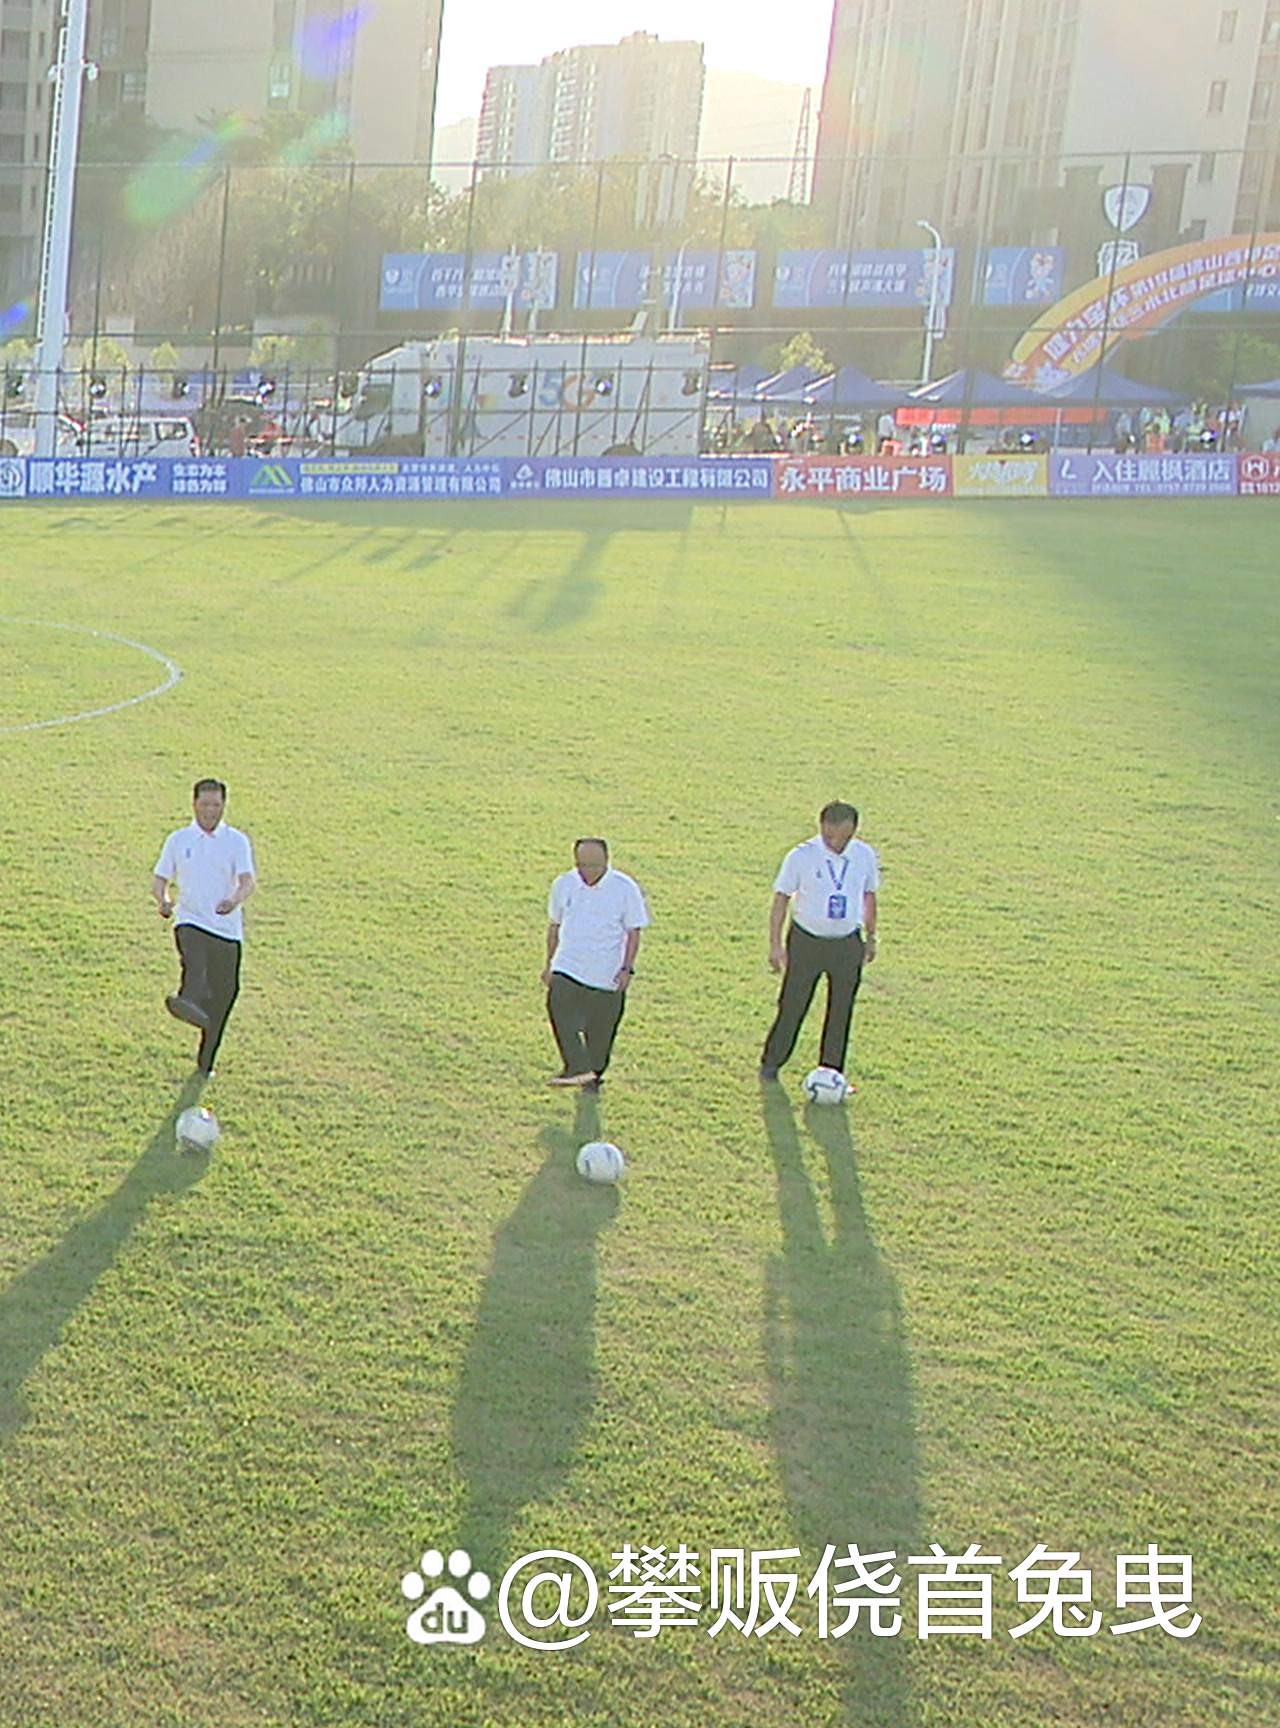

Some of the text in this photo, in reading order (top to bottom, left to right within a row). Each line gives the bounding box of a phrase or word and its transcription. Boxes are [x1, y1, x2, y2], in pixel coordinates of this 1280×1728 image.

[29, 460, 157, 495] 顺华源水产
[300, 475, 502, 494] 佛山市众邦人力资源管理有限公司
[780, 465, 947, 493] 永平商业广场
